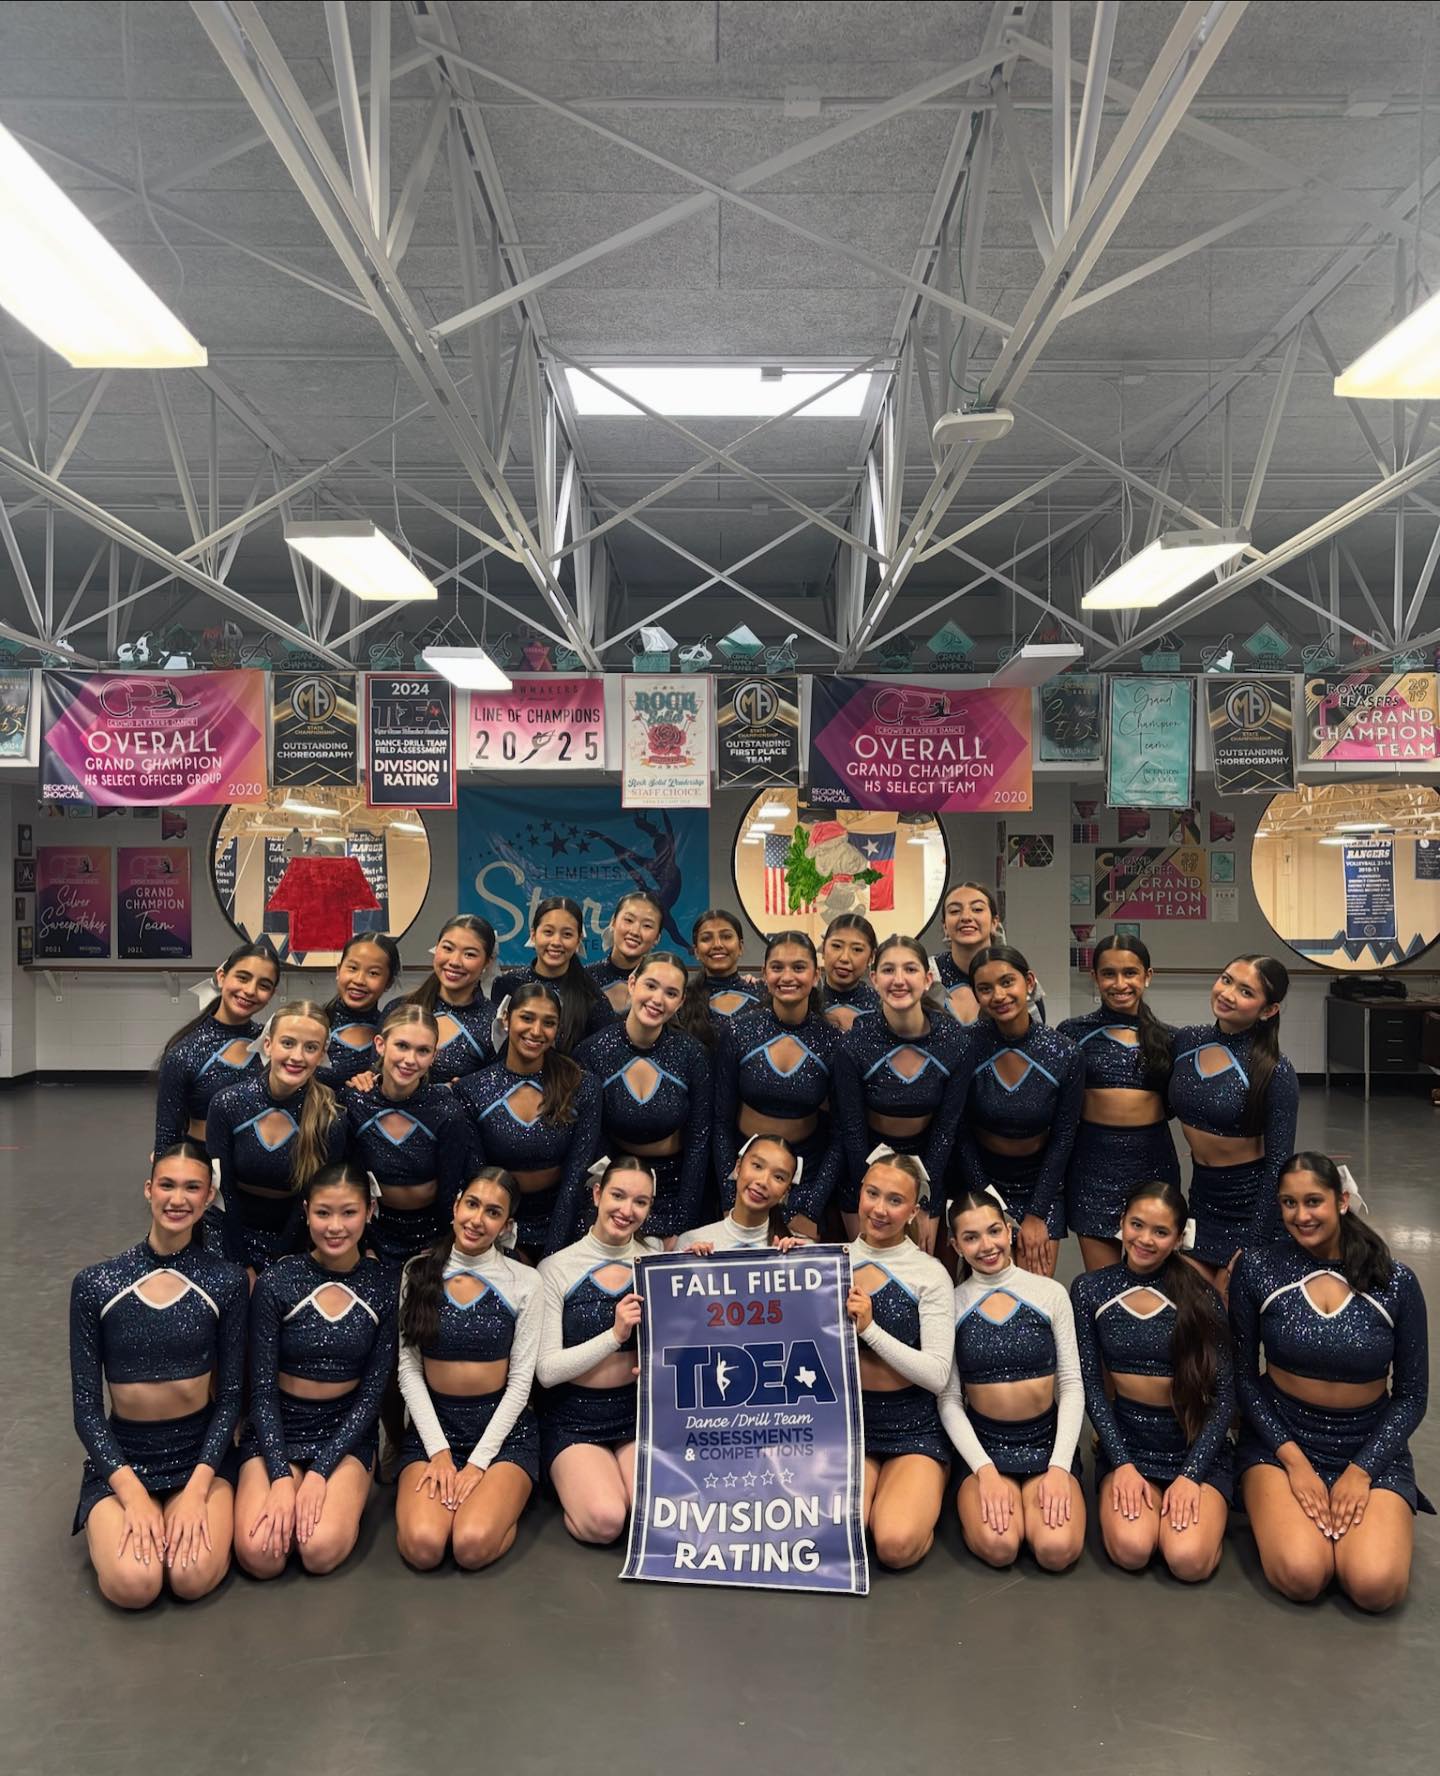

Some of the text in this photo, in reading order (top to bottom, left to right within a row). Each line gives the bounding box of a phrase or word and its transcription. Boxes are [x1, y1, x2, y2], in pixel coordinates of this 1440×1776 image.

[391, 683, 429, 695] 2024
[634, 691, 698, 714] ROCK
[1133, 687, 1174, 713] Grand
[371, 698, 450, 729] TDEA
[474, 707, 600, 723] LINE OF CHAMPIONS
[1356, 708, 1433, 724] GRAND
[1119, 711, 1180, 736] Champion
[1313, 725, 1435, 740] CHAMPION
[88, 730, 217, 754] OVERALL
[283, 742, 348, 750] OUTSTANDING
[375, 739, 424, 747] DANCE-DRILL
[726, 740, 791, 748] OUTSTANDING
[855, 735, 987, 760] OVERALL
[1136, 732, 1169, 755] Team
[277, 751, 353, 759] CHOREOGRAPHY
[375, 746, 447, 754] FIELD ASSESSMENT
[730, 748, 755, 756] FIRST
[1219, 749, 1284, 757] OUTSTANDING
[1376, 742, 1436, 757] TEAM
[85, 756, 222, 773] GRAND CHAMPION
[374, 759, 448, 773] DIVISION I
[1215, 757, 1289, 766] CHOREOGRAPHY
[846, 762, 994, 778] GRAND CHAMPION
[85, 772, 222, 786] HS SELECT OFFICER GROUP
[384, 773, 439, 786] RATING
[228, 783, 262, 796] 2020
[631, 788, 701, 797] STAFF CHOICE
[811, 788, 847, 796] REGIONAL
[864, 781, 976, 793] HS SELECT TEAM
[43, 791, 84, 799] SHOWCASE
[811, 795, 851, 803] SHOWCASE
[994, 791, 1027, 803] 2020
[1346, 849, 1390, 859] RANGERS
[1140, 878, 1201, 889] GRAND
[136, 887, 174, 898] GRAND
[1103, 891, 1201, 902] CHAMPION
[56, 885, 91, 916] Silver
[125, 898, 185, 910] CHAMPION
[1155, 904, 1201, 916] TEAM
[39, 907, 107, 942] Sweepstakes
[135, 910, 175, 939] Team
[671, 1268, 823, 1298] FALL FIELD
[706, 1301, 784, 1327] 2025
[662, 1340, 838, 1411] TDEA
[686, 1415, 730, 1429] Dance
[773, 1412, 814, 1425] Team
[685, 1427, 814, 1447] ASSESSMENTS
[684, 1443, 814, 1462] & COMPETITIONS
[652, 1495, 843, 1534] DIVISION I
[673, 1538, 820, 1573] RATING
